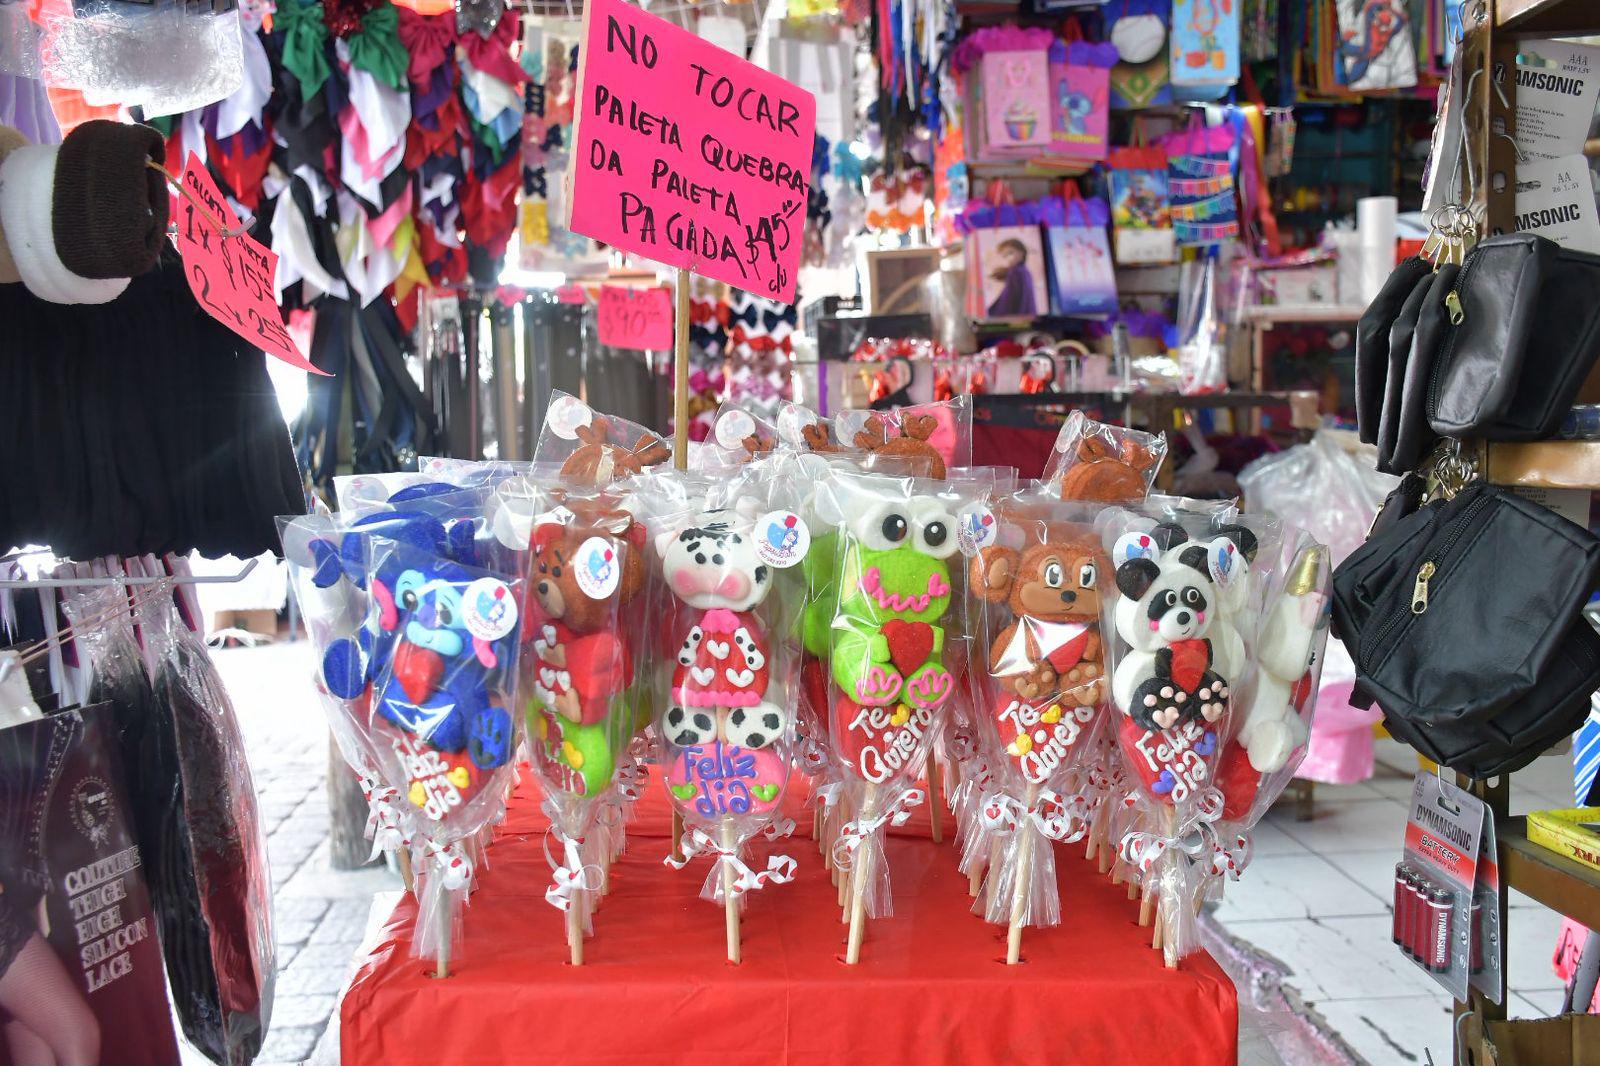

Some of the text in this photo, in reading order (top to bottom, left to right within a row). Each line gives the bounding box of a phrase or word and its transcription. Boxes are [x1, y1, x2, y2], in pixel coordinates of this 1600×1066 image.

[607, 14, 800, 137] NO TOCAR
[594, 84, 683, 152] PALETA
[590, 139, 741, 226] DA PALETA
[619, 192, 747, 279] PAGADA
[684, 740, 758, 783] Feliz
[848, 706, 935, 784] Te Quiero
[998, 700, 1095, 784] Te Quiero
[1415, 804, 1473, 852] DYNAMSONIC
[1420, 834, 1461, 864] BATTERY
[69, 877, 128, 920] THIGH
[76, 904, 124, 945] HIGH
[81, 917, 149, 969] SILICON
[1436, 912, 1448, 963] DYNAMSONIC
[85, 950, 133, 994] LACE
